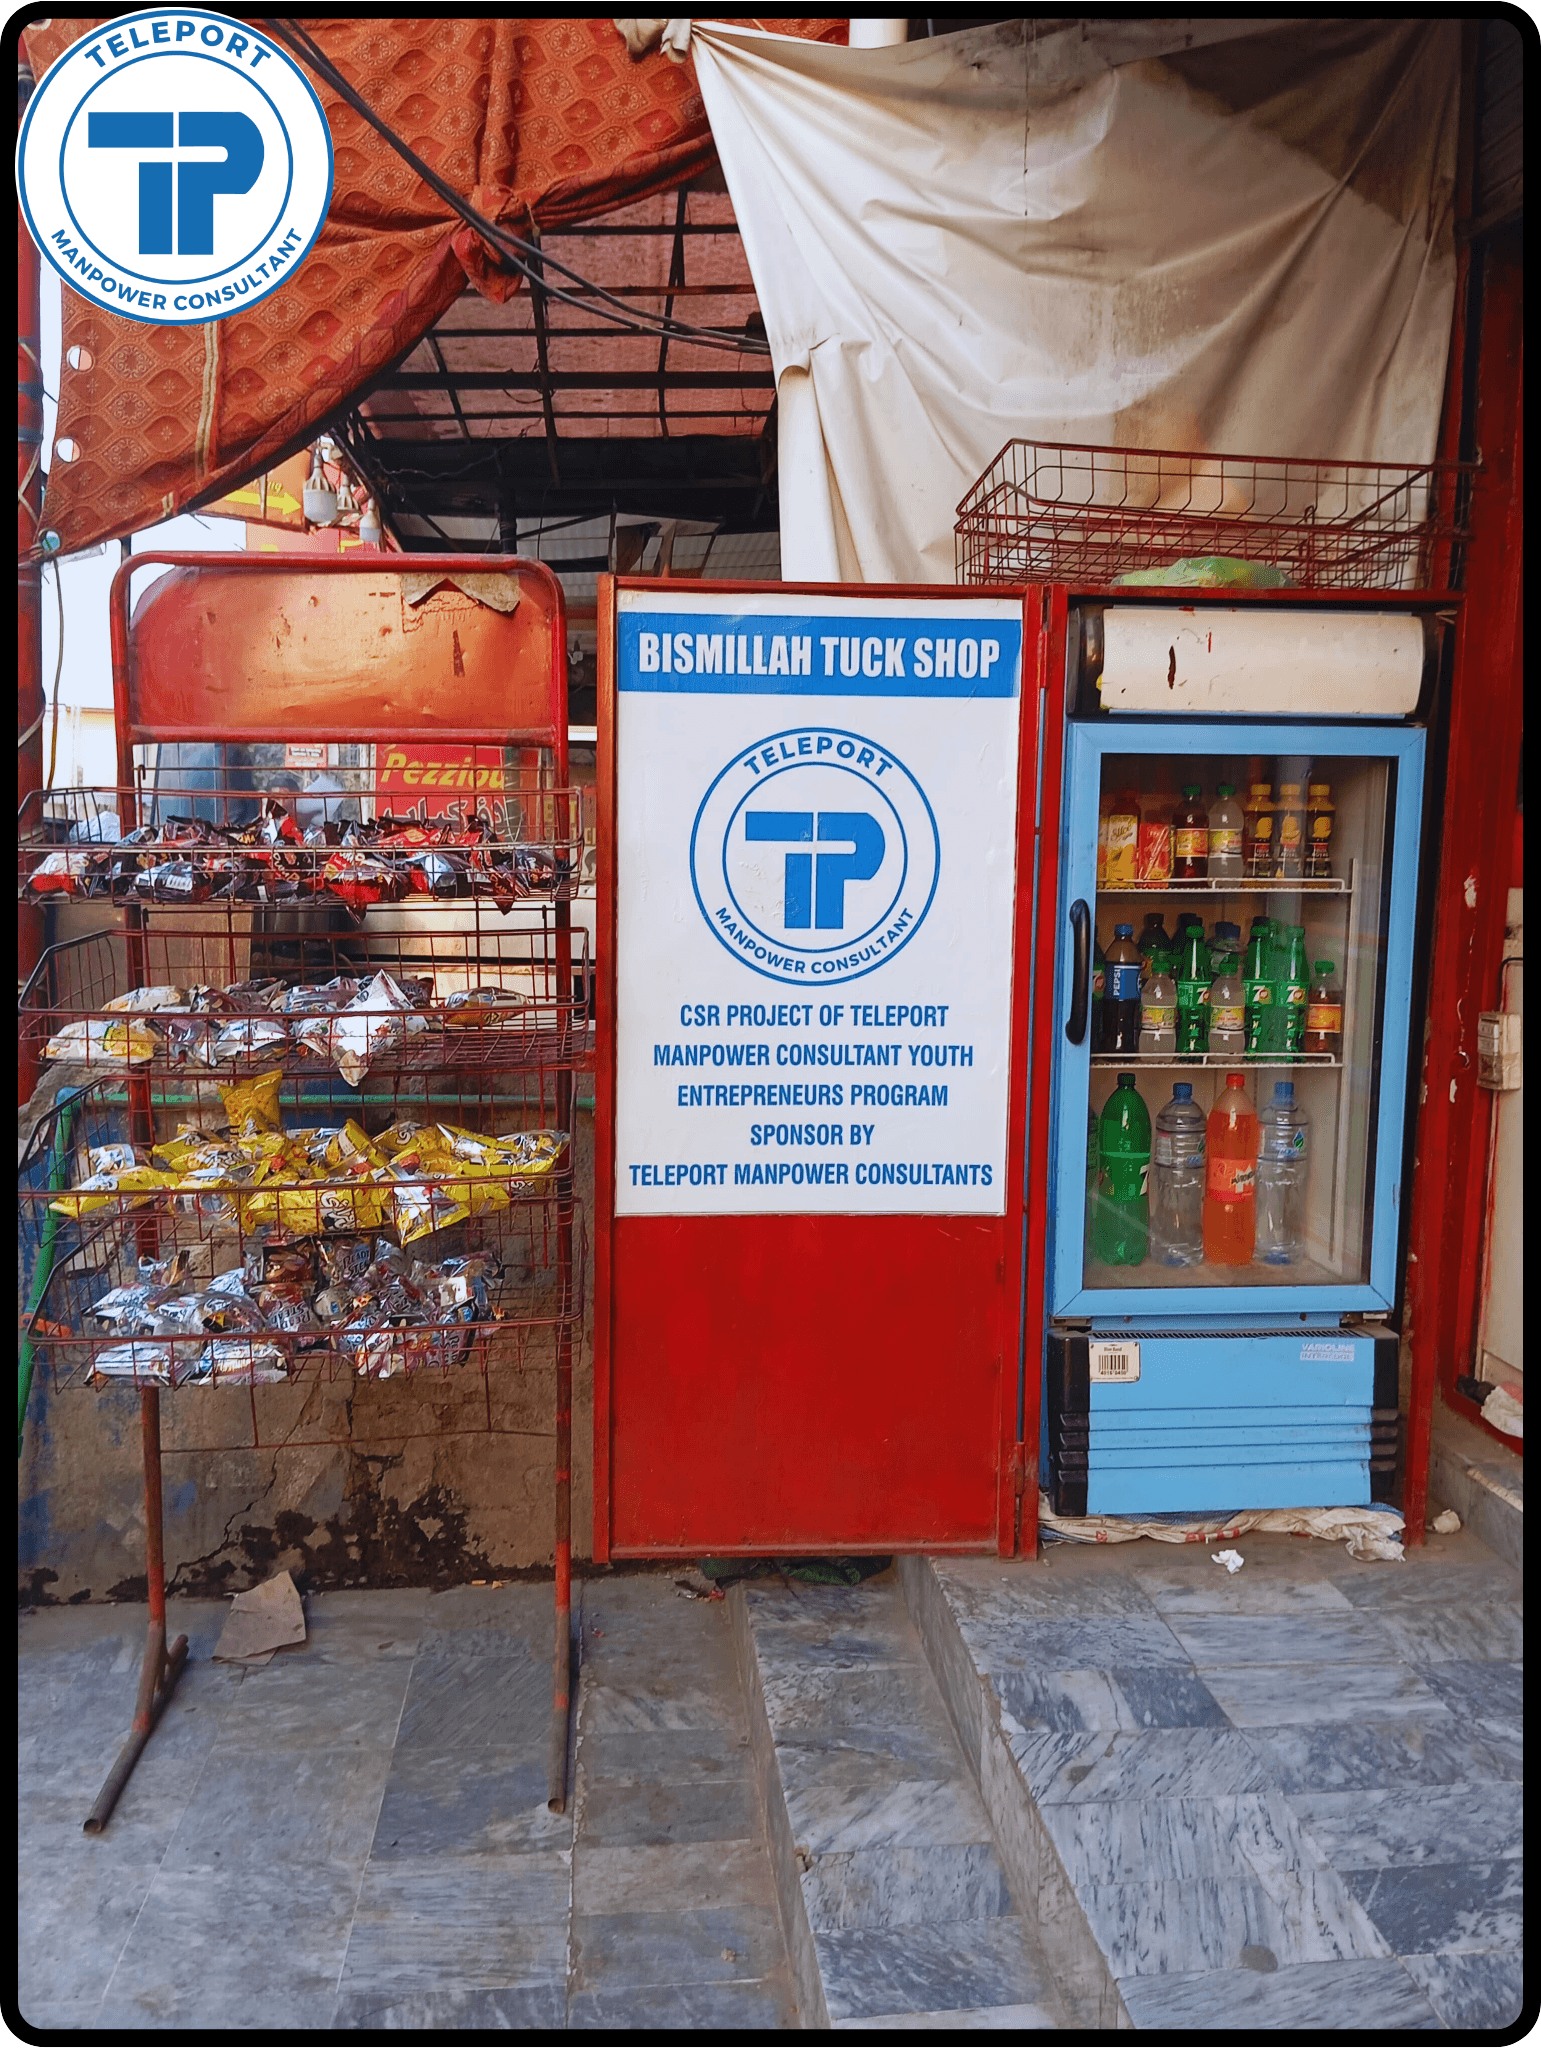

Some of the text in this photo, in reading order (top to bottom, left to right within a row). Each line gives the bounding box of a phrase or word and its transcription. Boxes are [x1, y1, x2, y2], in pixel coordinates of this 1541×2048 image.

[639, 633, 1000, 679] BISMILLAH TUCK SHOP
[742, 736, 893, 778] TELEPORT
[715, 906, 914, 975] MANPOWER CONSULTANT
[1113, 968, 1122, 996] PEPSI
[680, 1004, 950, 1028] CSR PROJECT OF TELEPORT
[653, 1043, 974, 1067] MANPOWER CONSULTANT YOUTH
[677, 1084, 949, 1107] ENTREPRENEURS PROGRAM
[750, 1123, 875, 1146] SPONSOR BY
[628, 1163, 993, 1186] TELEPORT MANPOWER CONSULTANTS
